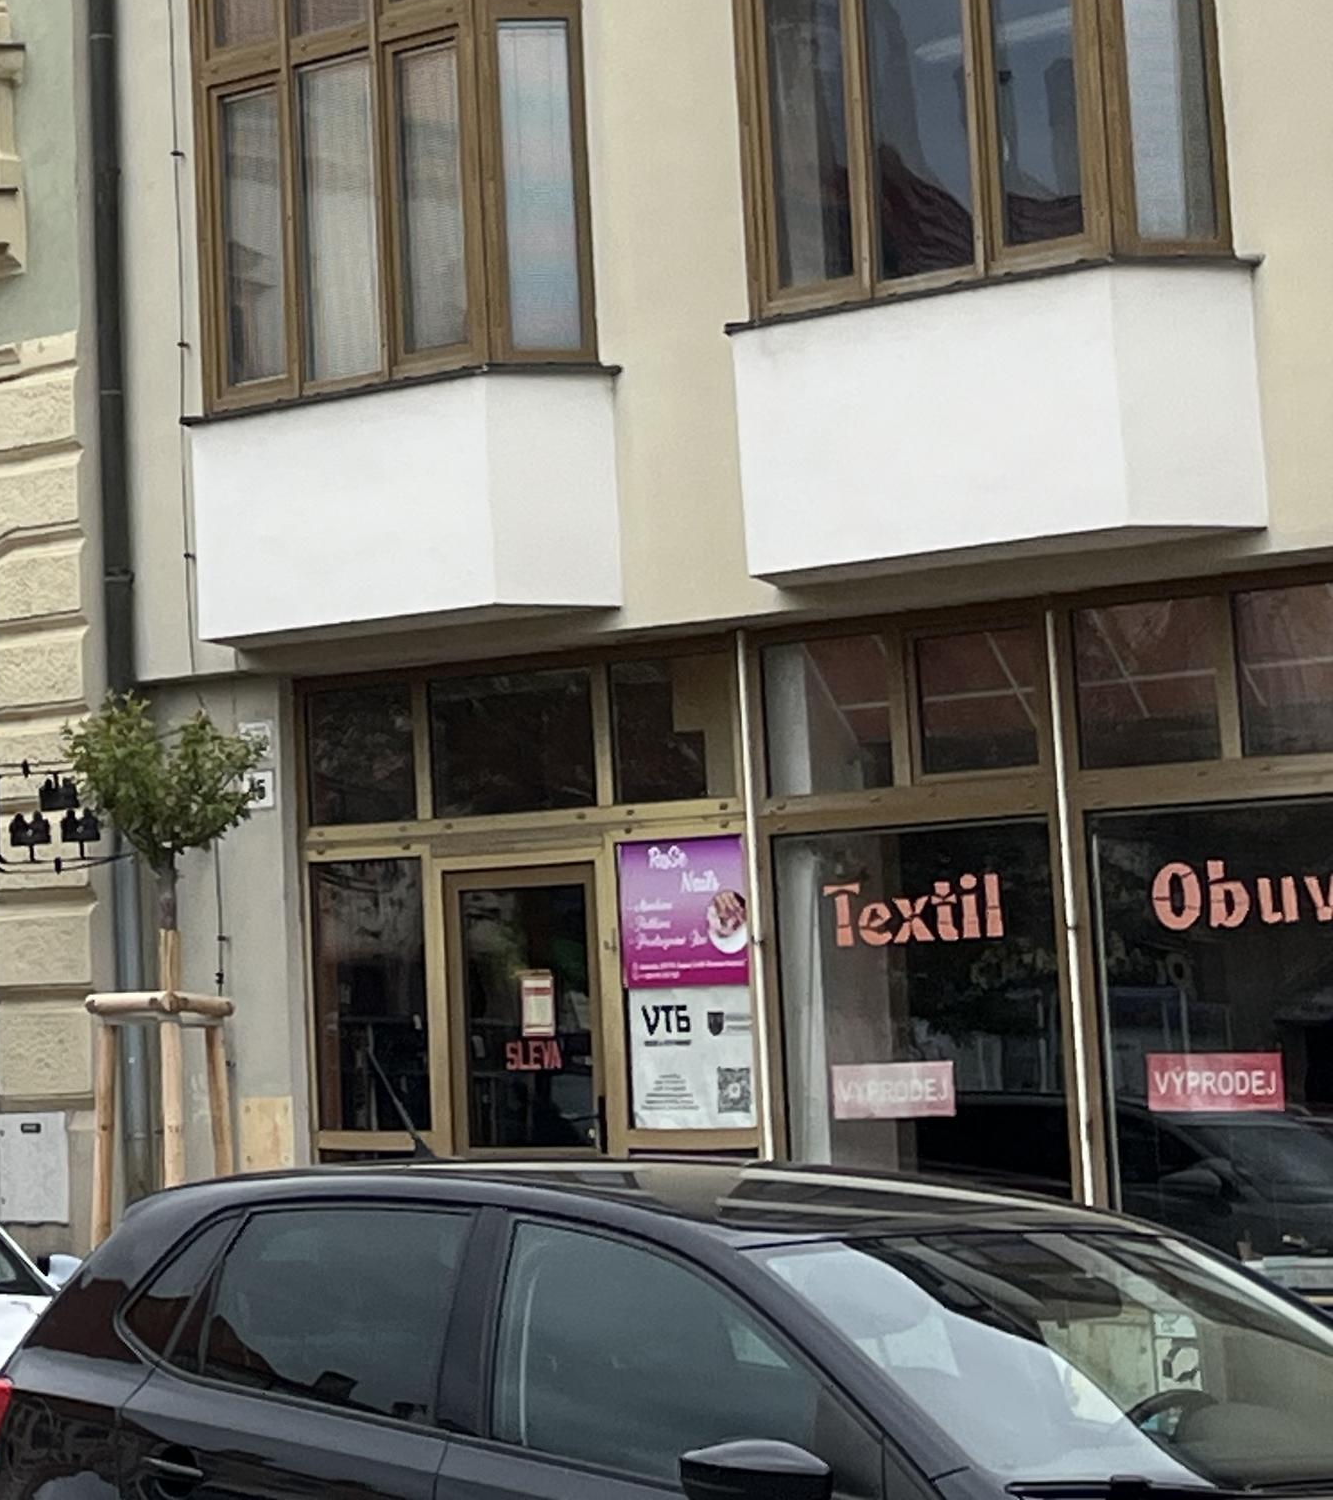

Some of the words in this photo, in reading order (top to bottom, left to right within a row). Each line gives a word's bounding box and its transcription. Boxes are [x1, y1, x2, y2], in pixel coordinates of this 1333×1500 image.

[822, 873, 1004, 947] Textil
[1152, 860, 1333, 931] Obuv
[505, 1040, 563, 1071] SLEVA
[1154, 1066, 1277, 1096] VÝPRODEJ
